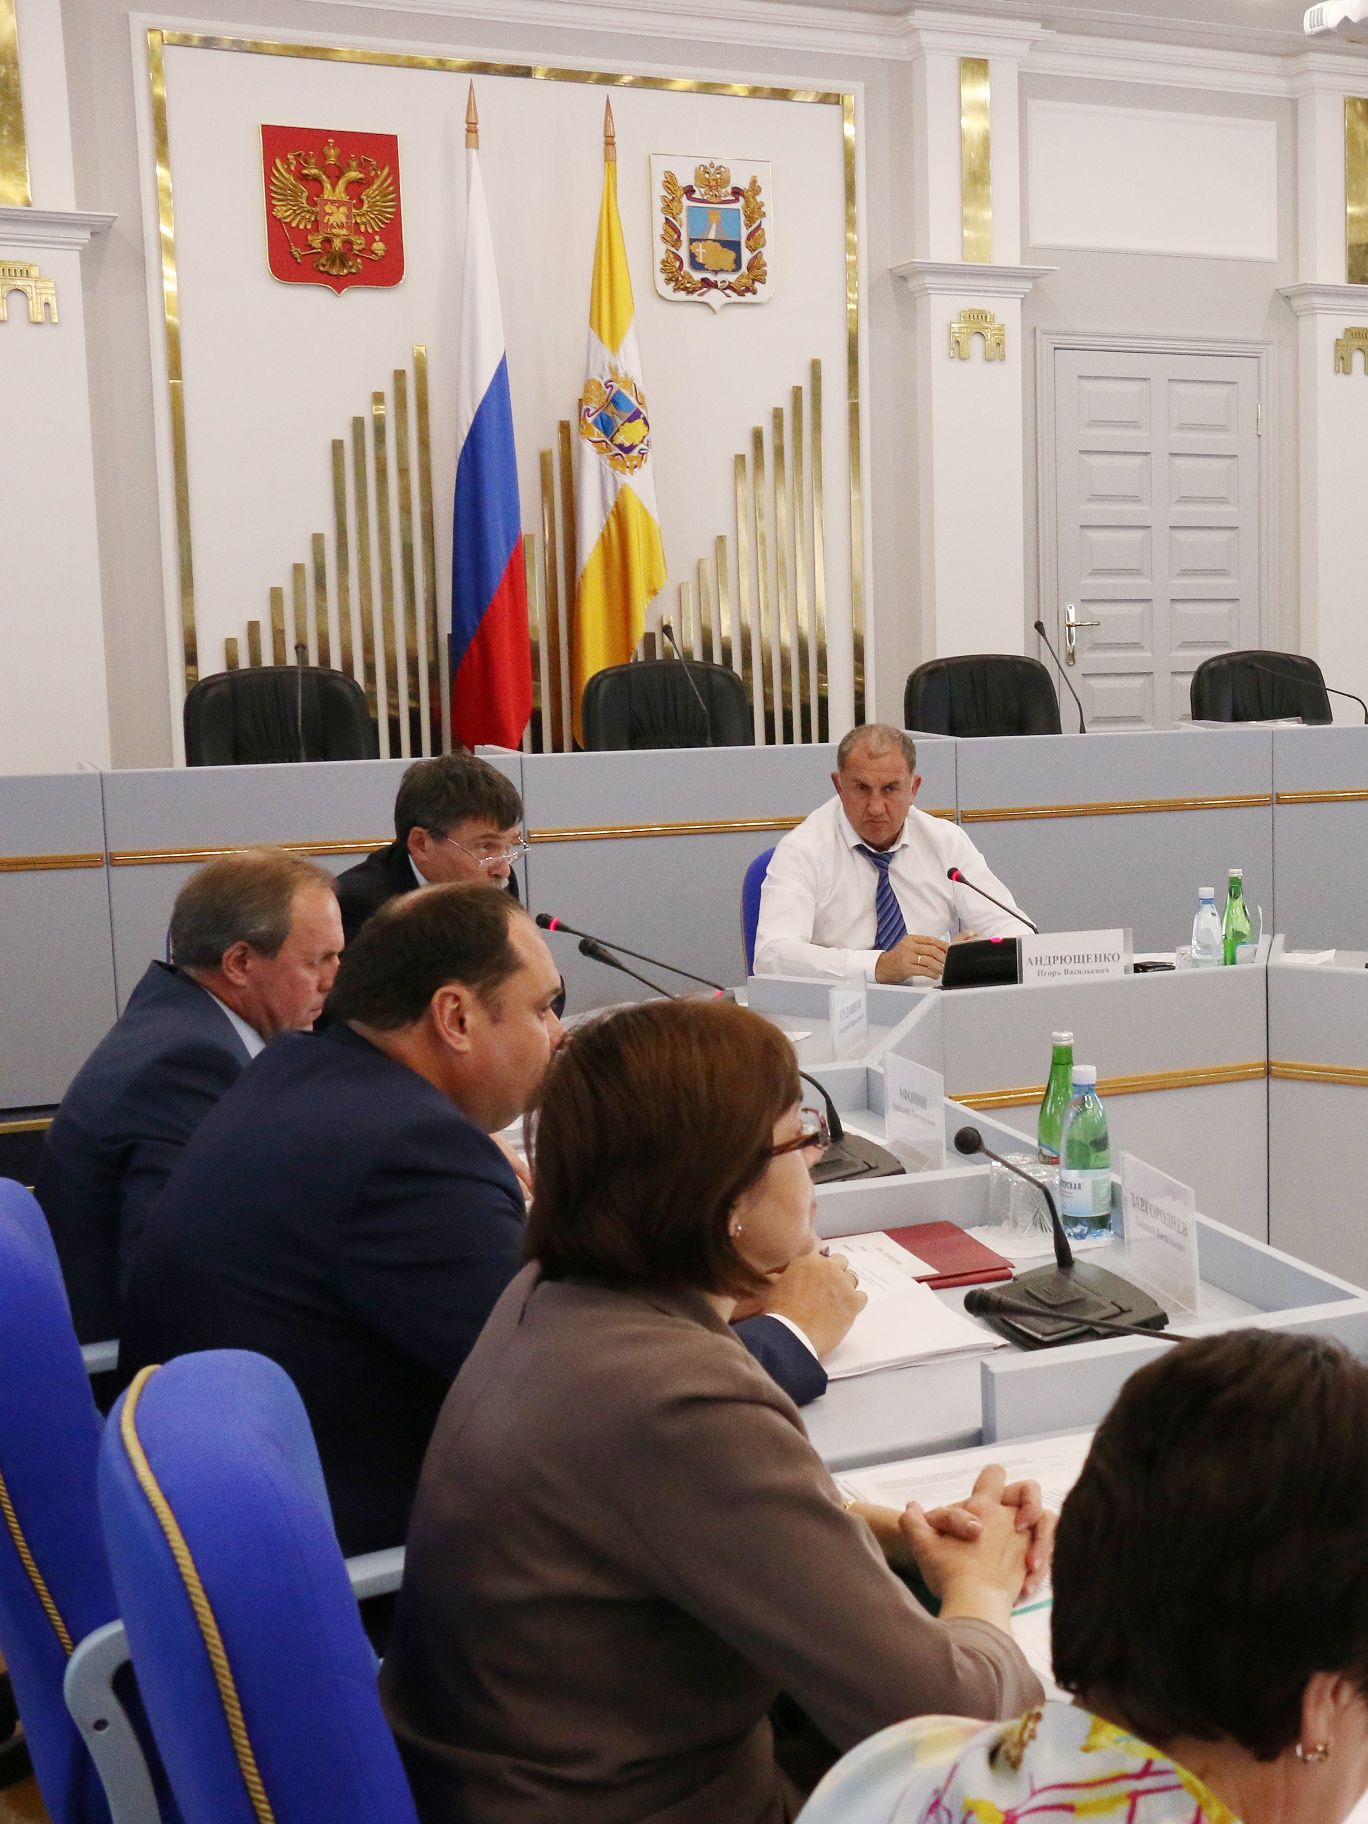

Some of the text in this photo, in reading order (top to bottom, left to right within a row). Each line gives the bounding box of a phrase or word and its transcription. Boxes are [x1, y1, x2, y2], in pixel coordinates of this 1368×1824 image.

[1026, 953, 1121, 966] АНДРЮЩЕНКО
[1037, 968, 1110, 978] Игорь Васильевич
